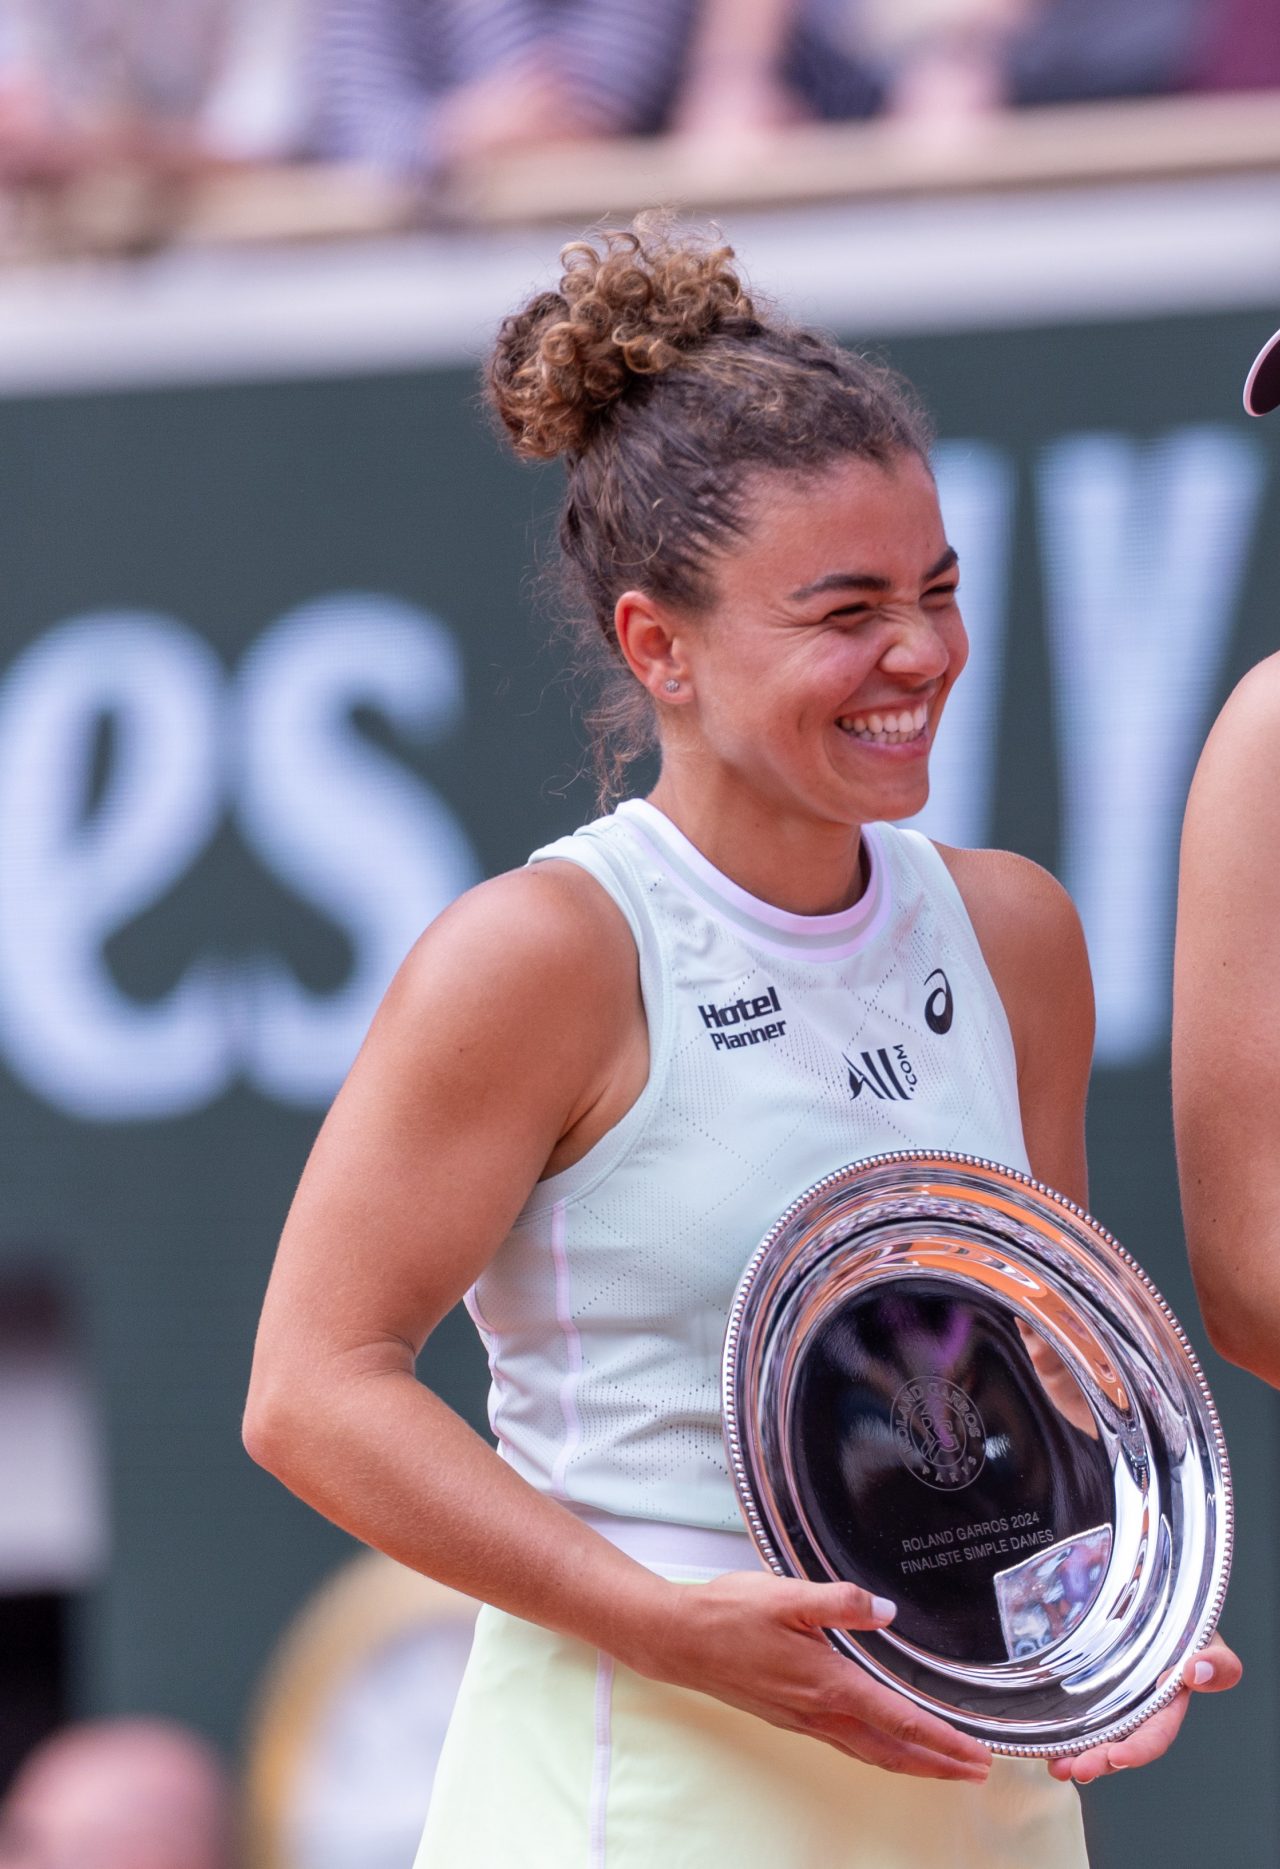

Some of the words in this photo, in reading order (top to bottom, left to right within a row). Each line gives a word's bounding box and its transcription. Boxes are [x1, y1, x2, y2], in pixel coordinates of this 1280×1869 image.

[928, 425, 1272, 1072] Y
[698, 986, 783, 1029] Hotel
[710, 1020, 788, 1051] Planner
[900, 1550, 963, 1575] FINALISTE
[963, 1539, 1009, 1561] SIMPLE
[1010, 1528, 1054, 1550] DAMES
[901, 1530, 953, 1553] ROLAND
[955, 1518, 1009, 1542] GARROS
[1010, 1511, 1040, 1529] 2024
